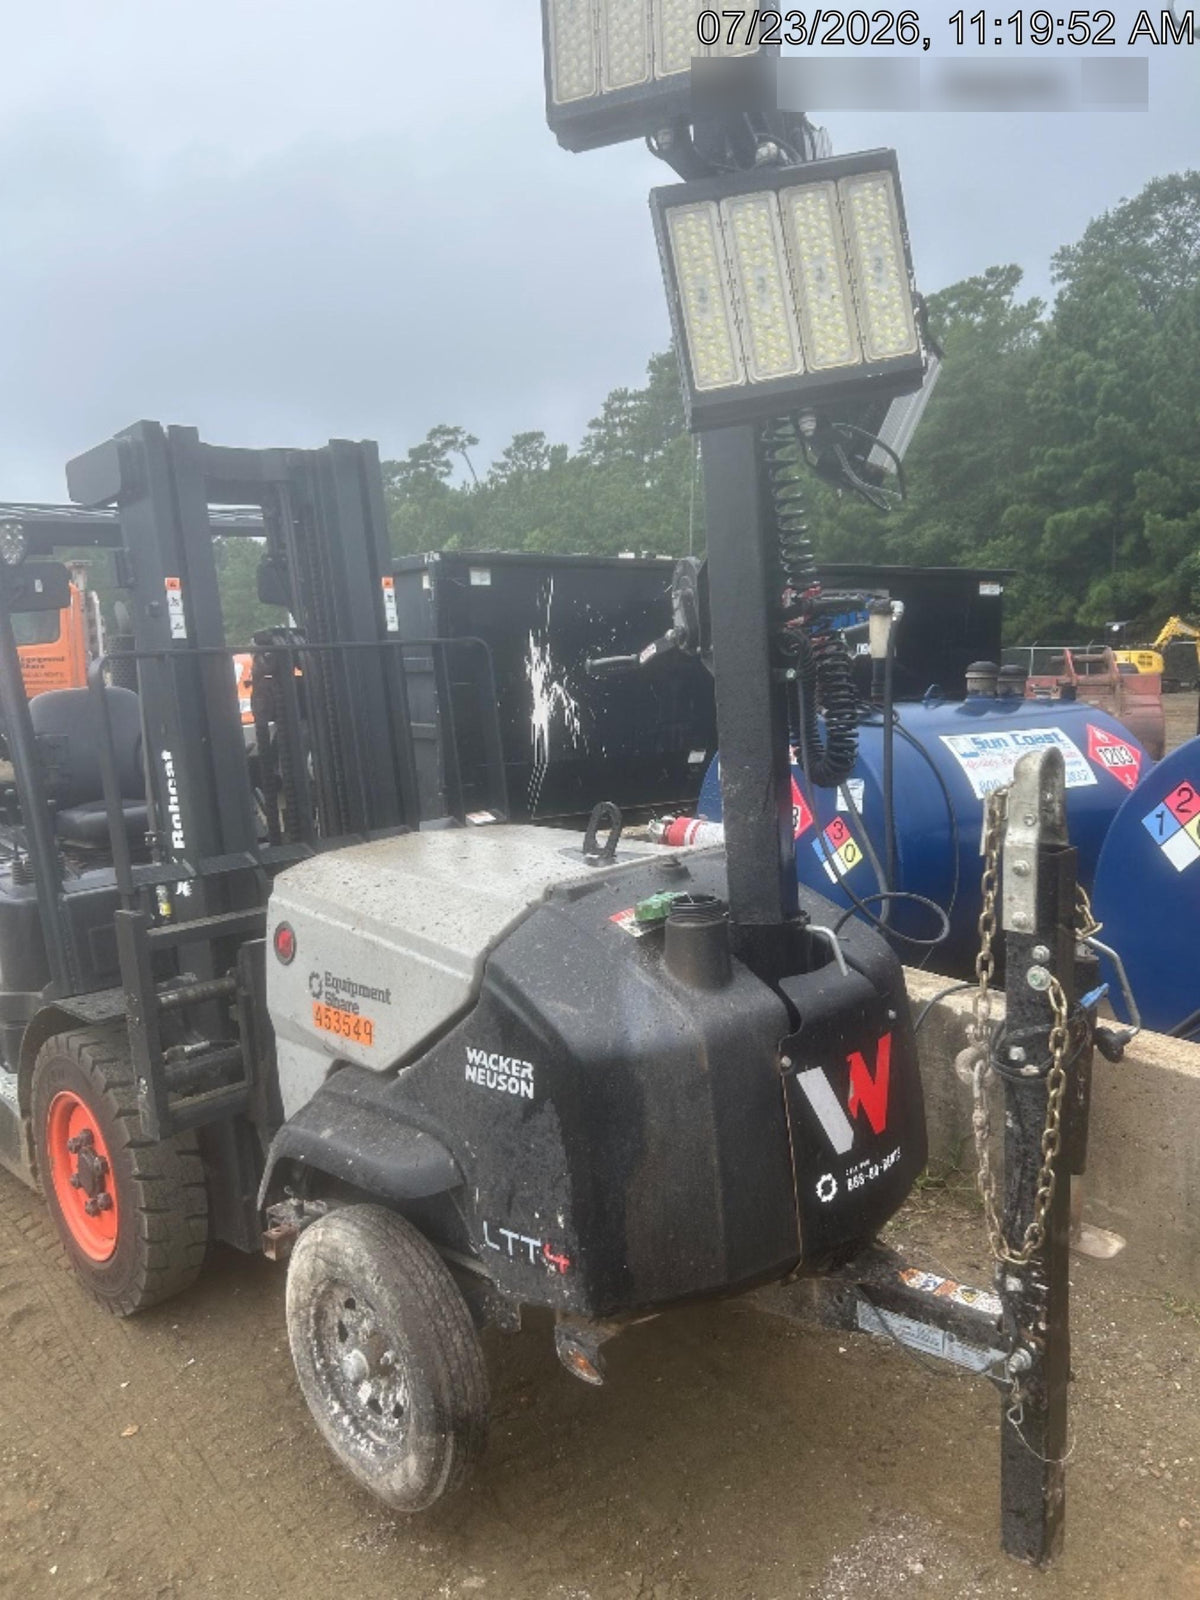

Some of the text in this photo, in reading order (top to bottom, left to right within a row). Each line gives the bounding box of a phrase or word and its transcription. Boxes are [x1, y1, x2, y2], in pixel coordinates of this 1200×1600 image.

[970, 731, 1065, 750] Sun Coast
[1098, 746, 1134, 766] 1203
[1175, 786, 1194, 813] 2
[833, 820, 844, 840] 3
[1155, 810, 1165, 836] 1
[844, 843, 856, 863] 0
[324, 970, 391, 1005] Equipment
[324, 991, 360, 1015] Share
[314, 1005, 373, 1045] 453549
[465, 1046, 535, 1081] WACKER
[465, 1064, 535, 1100] NEUSON
